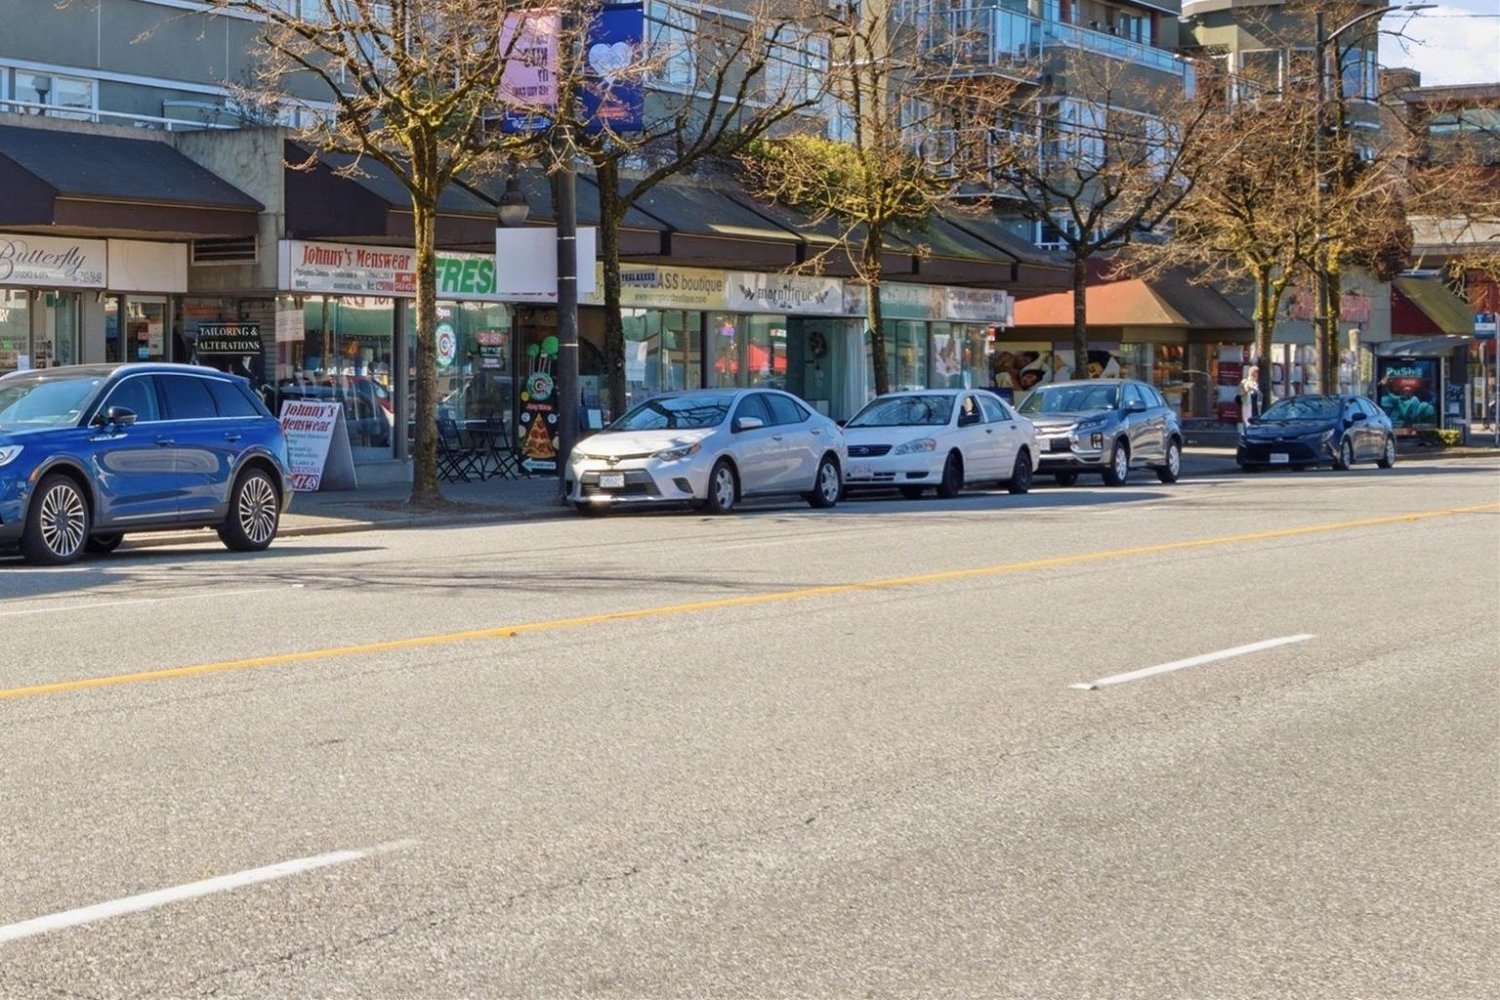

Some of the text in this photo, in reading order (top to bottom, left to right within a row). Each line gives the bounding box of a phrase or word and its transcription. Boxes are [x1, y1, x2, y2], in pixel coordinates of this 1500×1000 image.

[301, 245, 411, 270] Johnny's Menswear
[435, 258, 496, 294] FRES
[682, 275, 722, 295] boutique
[199, 327, 258, 336] TAILORING &
[199, 341, 260, 350] ALTERATIONS
[284, 403, 336, 419] Johnny's
[282, 418, 331, 432] Menswear
